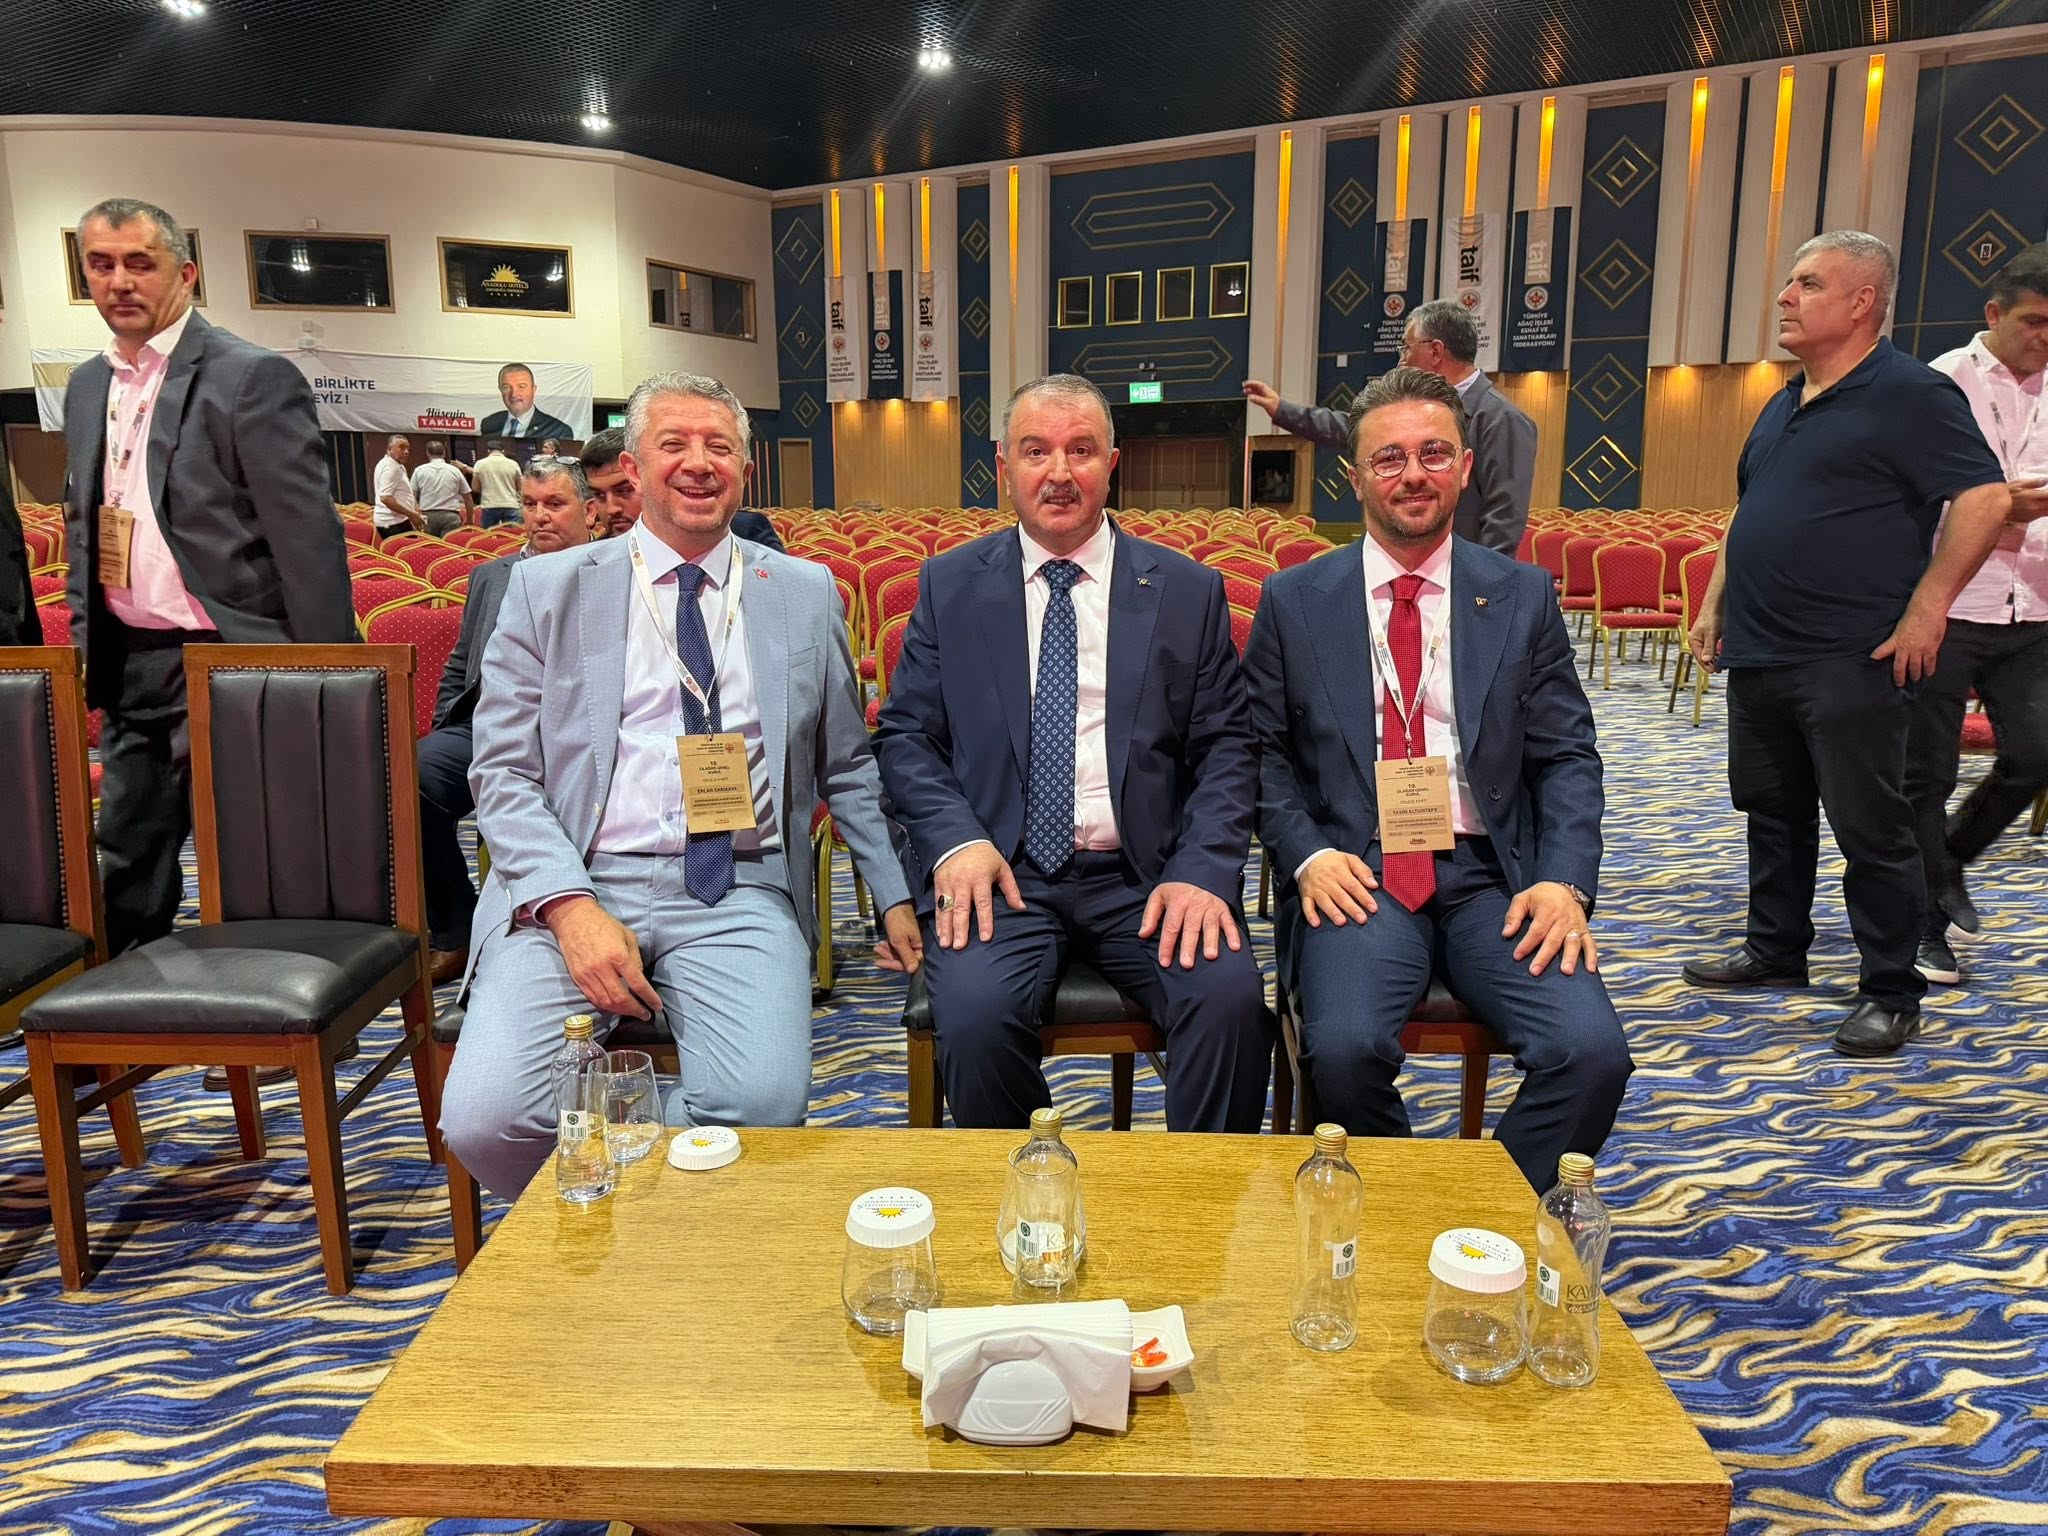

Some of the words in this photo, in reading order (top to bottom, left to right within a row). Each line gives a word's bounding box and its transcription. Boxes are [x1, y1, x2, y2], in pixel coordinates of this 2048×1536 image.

[1460, 245, 1480, 282] taif
[831, 300, 844, 330] taif
[919, 296, 933, 327] taif
[314, 376, 376, 390] BİRLİKTE
[314, 391, 343, 404] EYİZ
[426, 408, 466, 419] Hüseyin
[421, 418, 472, 428] TAKLACI
